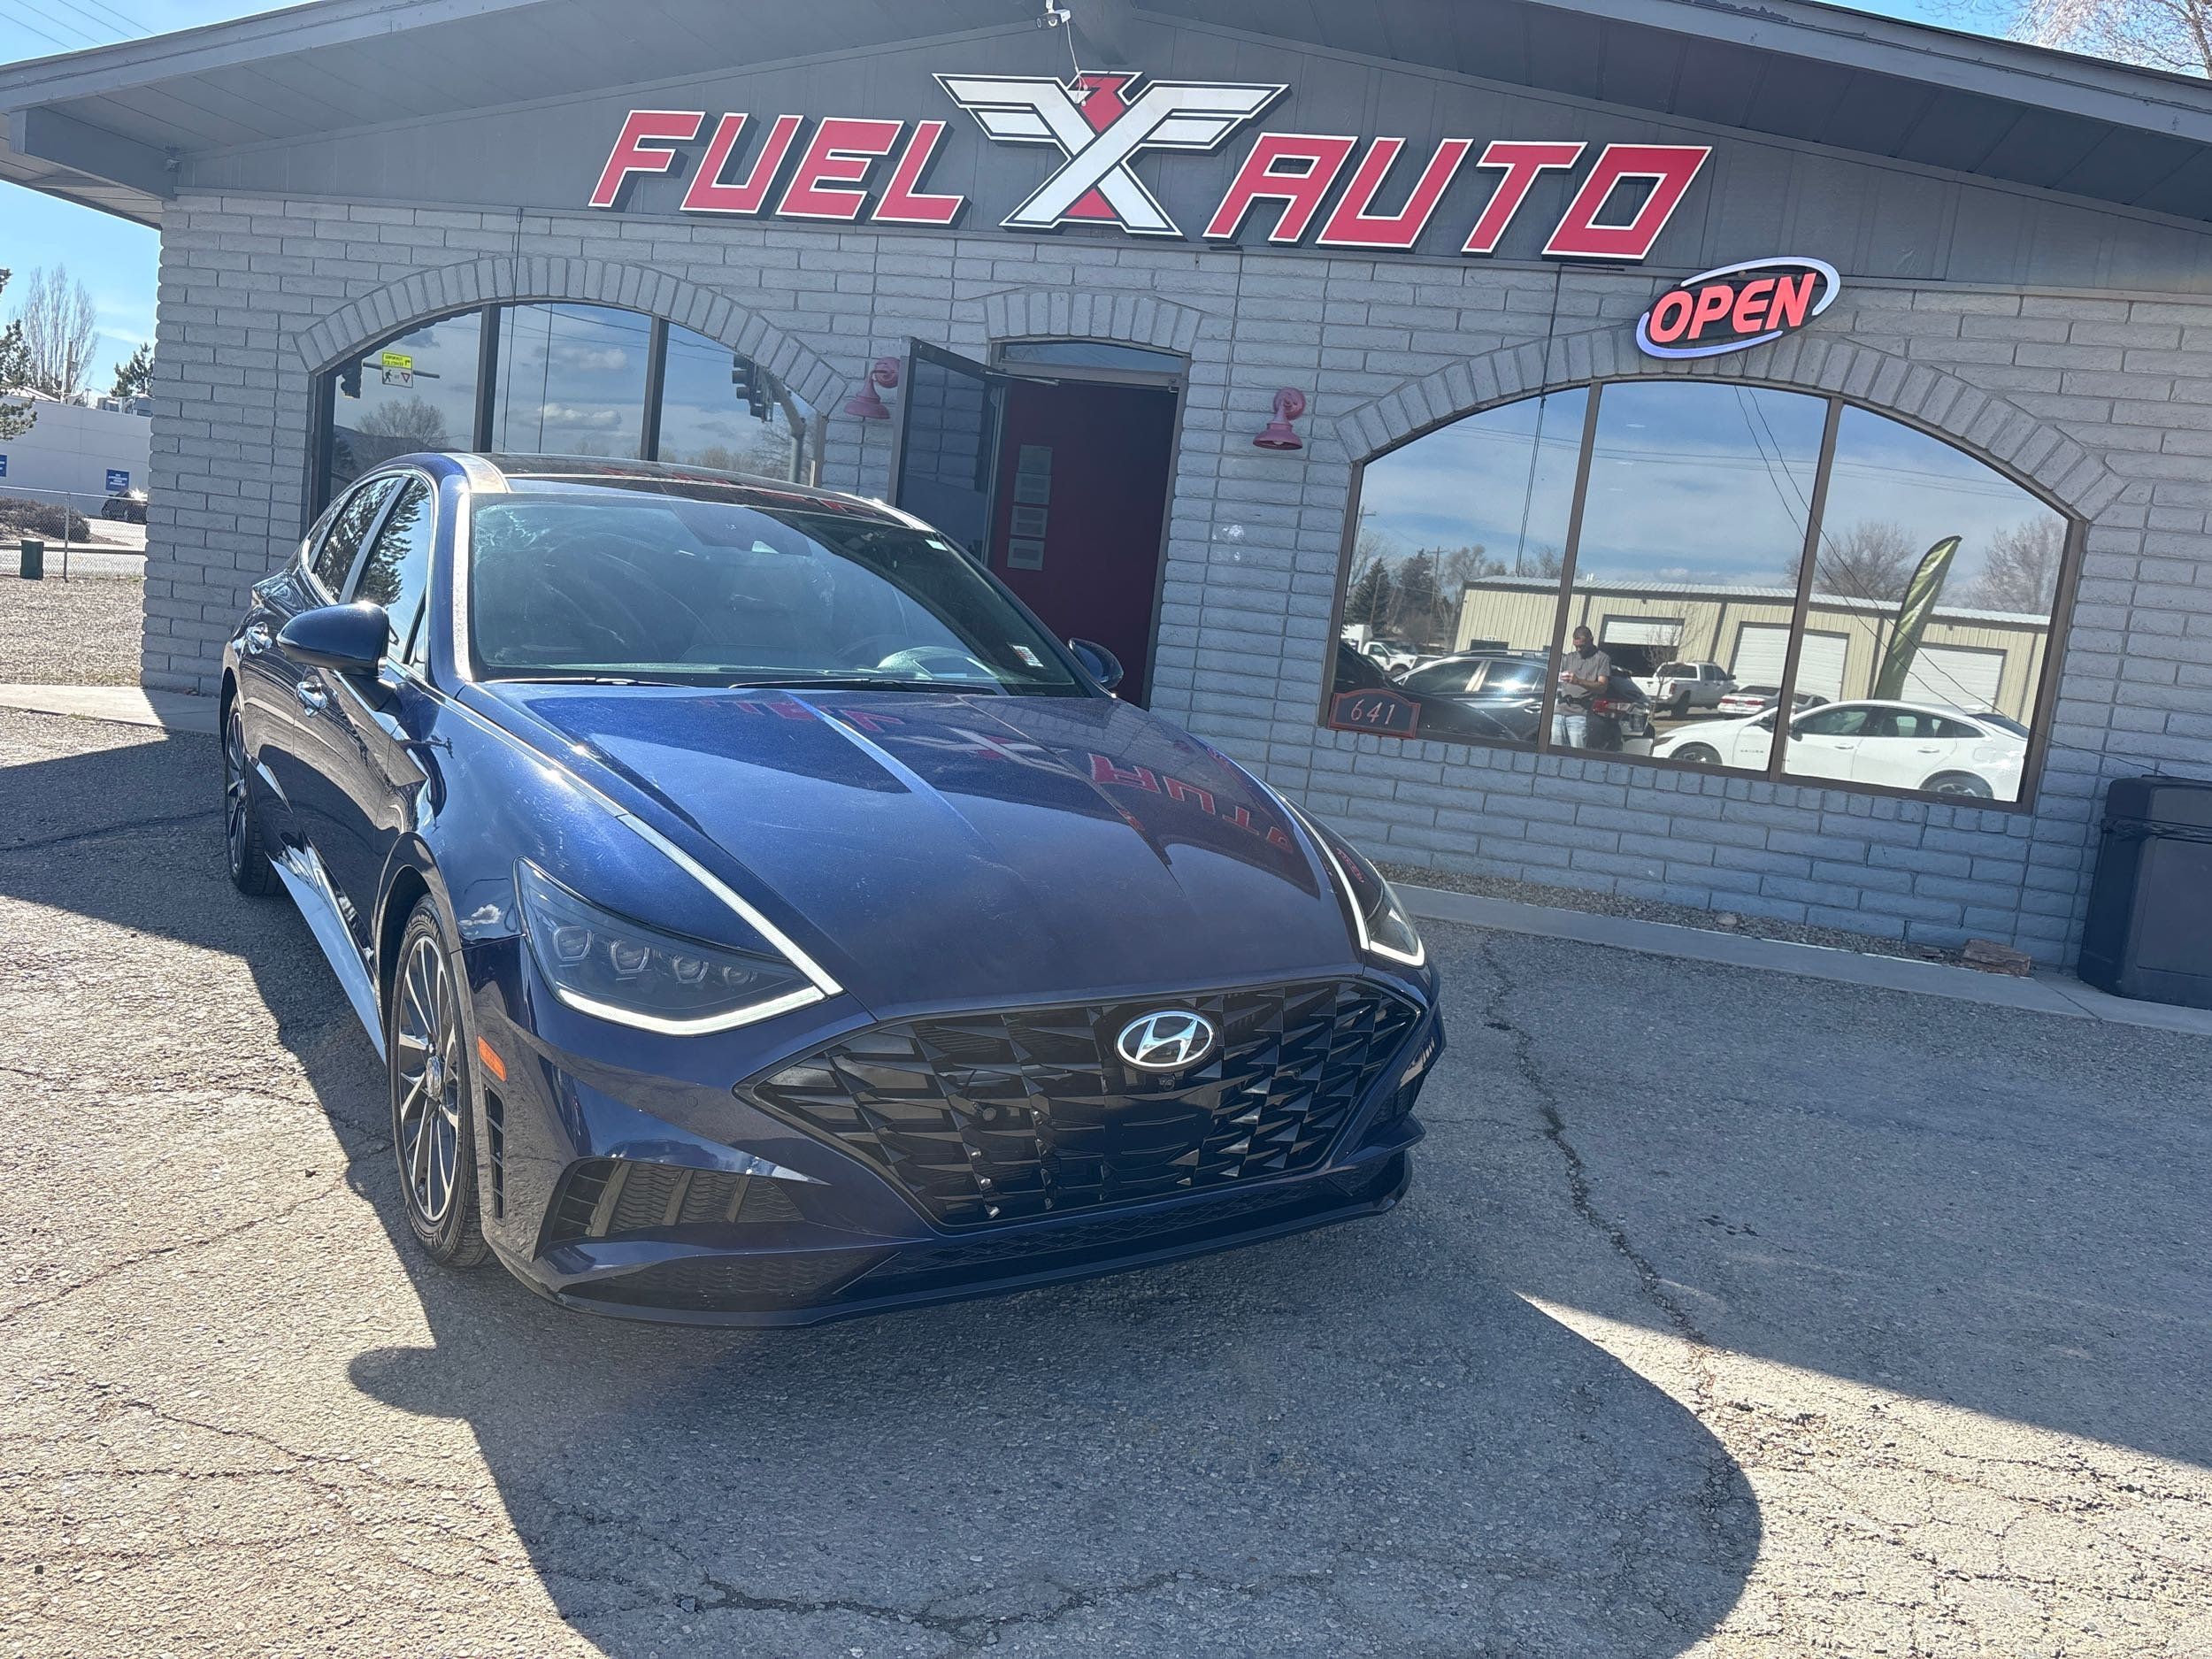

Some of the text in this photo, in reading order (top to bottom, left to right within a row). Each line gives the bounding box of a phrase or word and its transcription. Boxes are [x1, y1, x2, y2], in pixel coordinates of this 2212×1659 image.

[588, 71, 1714, 262] FUEL X AUTO
[1649, 273, 1816, 343] OPEN
[1350, 698, 1395, 726] 641
